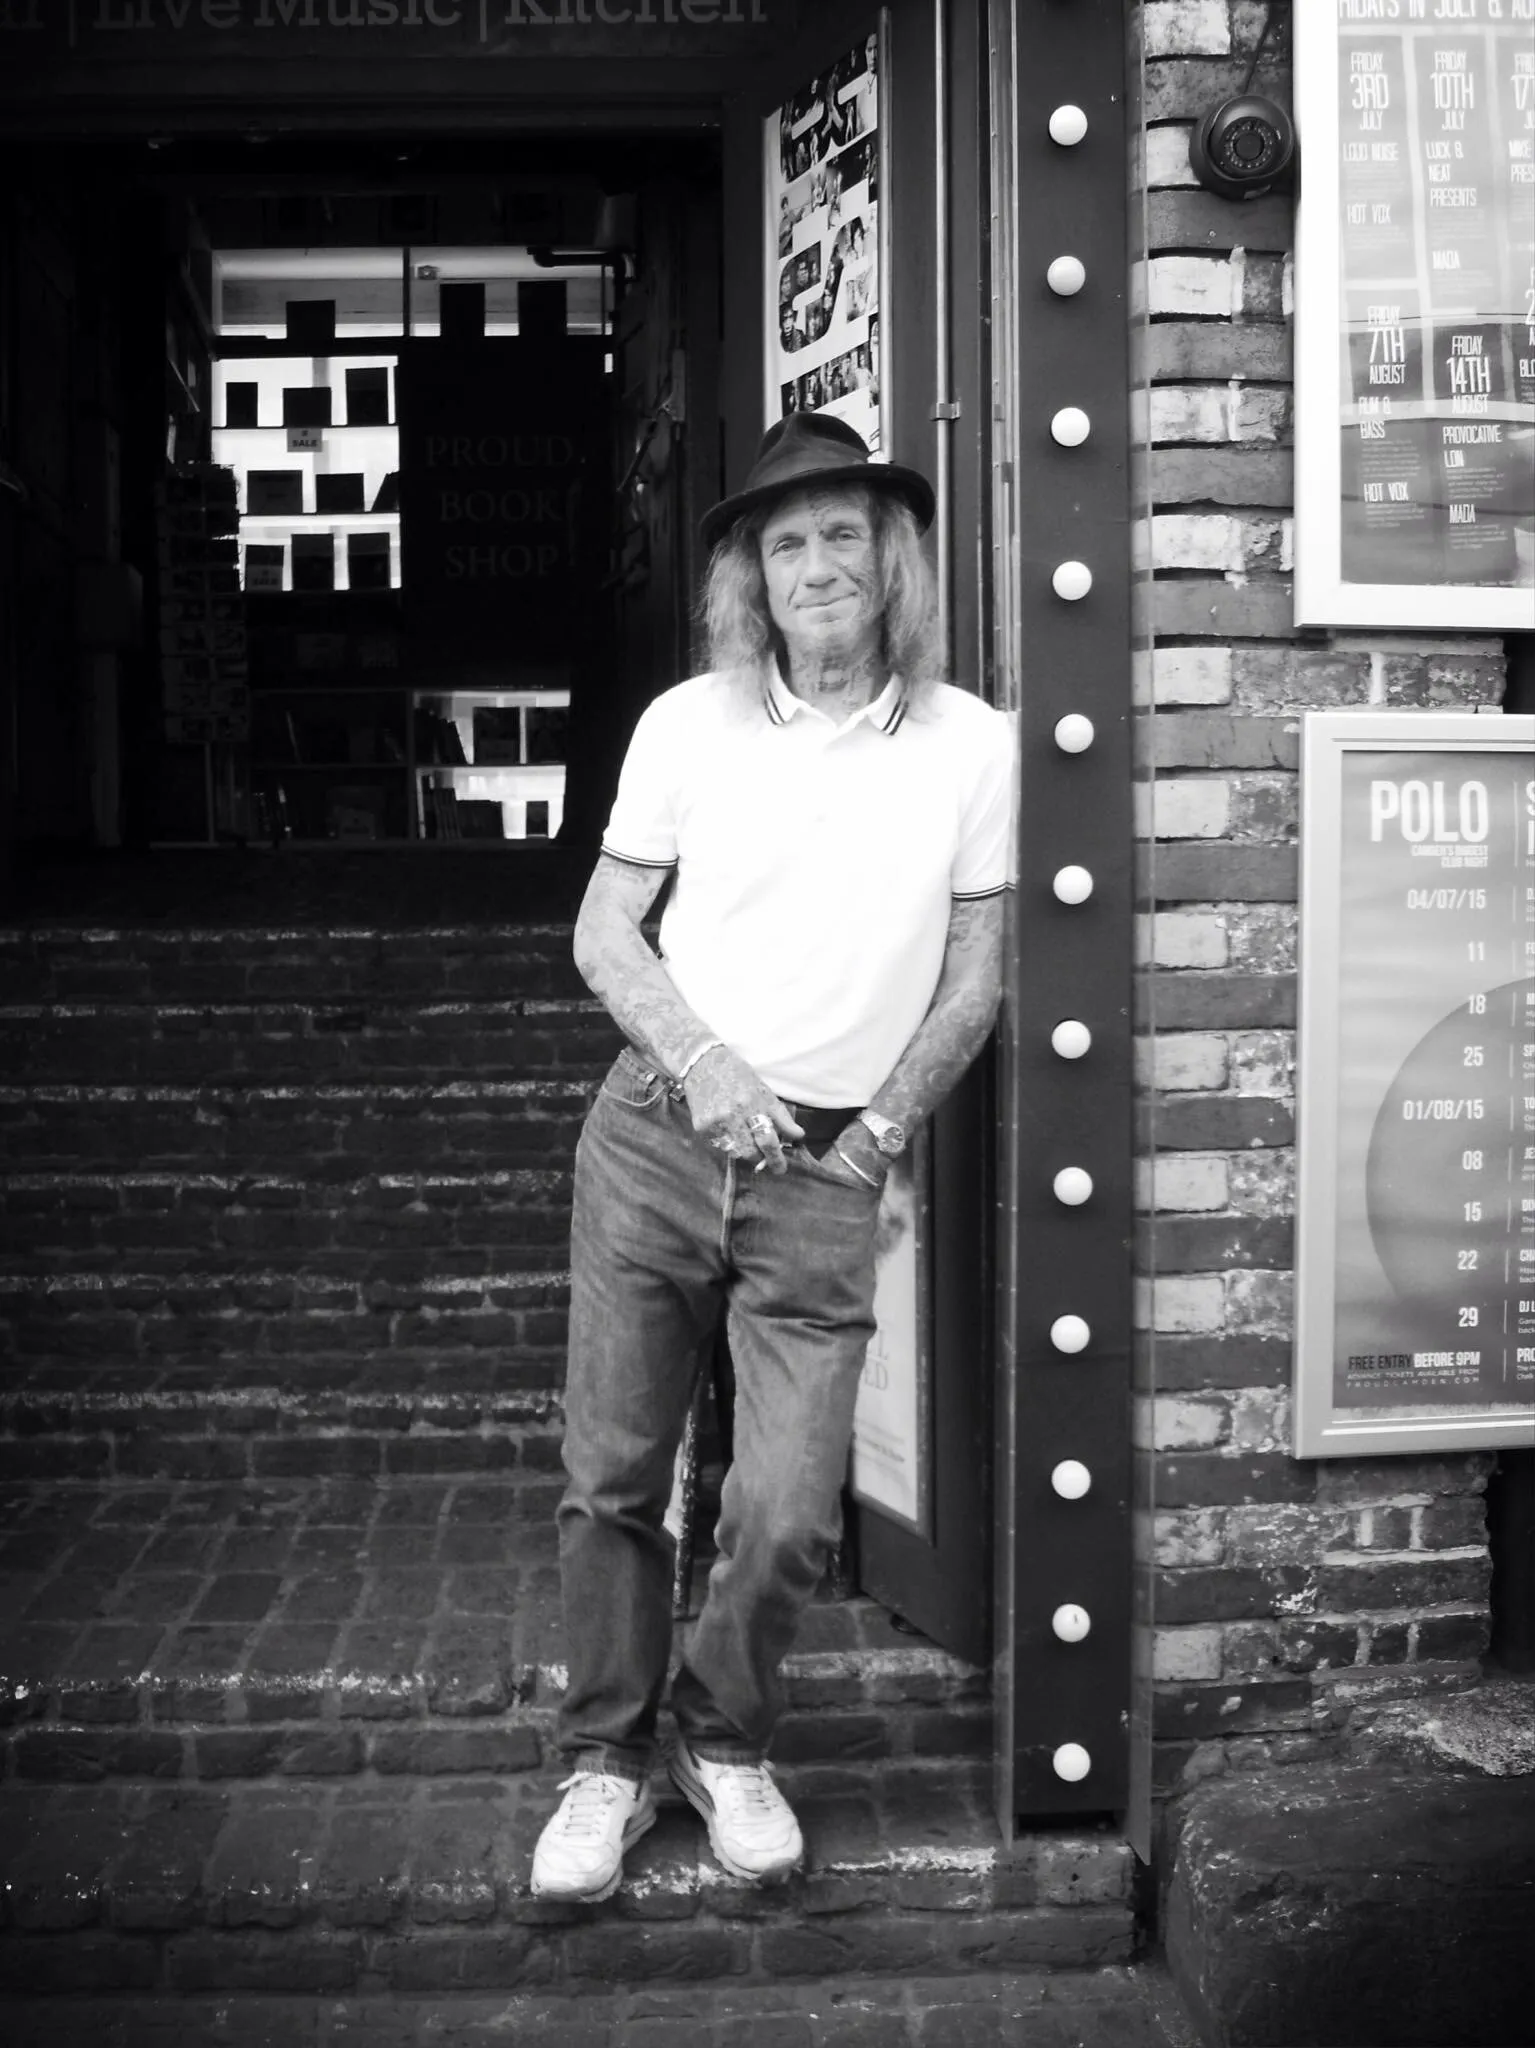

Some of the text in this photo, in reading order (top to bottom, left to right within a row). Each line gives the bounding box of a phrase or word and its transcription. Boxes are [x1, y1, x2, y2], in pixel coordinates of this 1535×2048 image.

[1350, 52, 1384, 72] FRIDAY
[1434, 50, 1466, 71] FRIDAY
[1350, 72, 1389, 109] 3RD
[1429, 72, 1475, 109] 10TH
[1359, 110, 1384, 130] JULY
[1441, 110, 1465, 130] JULY
[1429, 187, 1477, 207] PRESENTS
[1346, 203, 1392, 225] HOT VOX
[1367, 306, 1401, 326] FRIDAY
[1367, 326, 1405, 363] 7TH
[1451, 335, 1483, 356] FRIDAY
[1369, 364, 1406, 384] AUGUST
[1446, 356, 1491, 393] 14TH
[1451, 394, 1489, 414] AUGUST
[1360, 420, 1386, 439] BASS
[1442, 424, 1503, 444] PROVOCATIVE
[424, 434, 573, 467] PROUD
[1363, 482, 1409, 502] HOT VOX
[439, 489, 562, 522] BOOK
[444, 544, 559, 578] SHOP
[1371, 780, 1489, 842] POLO
[1407, 888, 1487, 911] 04/07/15
[1467, 941, 1485, 963] 11
[1468, 993, 1487, 1015] 18
[1463, 1046, 1484, 1067] 25
[1403, 1099, 1485, 1120] 01/08/15
[1462, 1150, 1484, 1171] 08
[1464, 1201, 1482, 1222] 15
[1457, 1250, 1478, 1271] 22
[1458, 1306, 1479, 1328] 29
[1348, 1351, 1480, 1370] FREE ENTRY BEFORE 9PM
